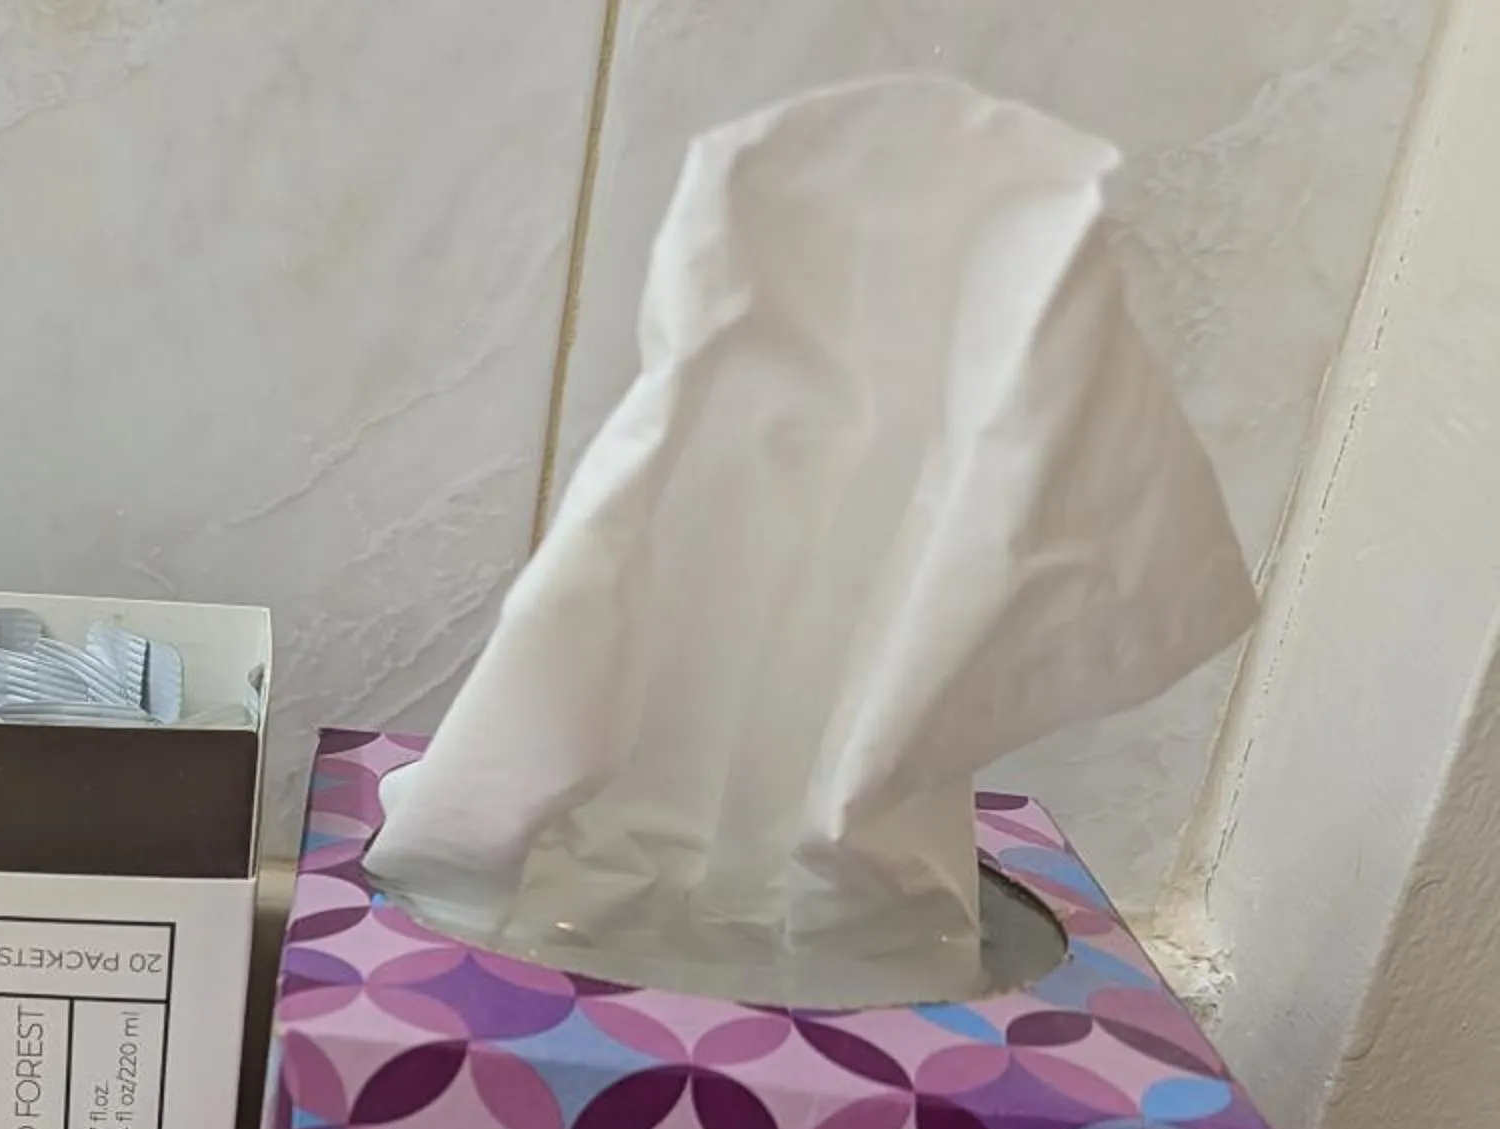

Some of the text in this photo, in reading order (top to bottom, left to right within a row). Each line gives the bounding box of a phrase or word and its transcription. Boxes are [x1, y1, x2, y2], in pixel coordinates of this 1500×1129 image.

[129, 951, 163, 973] 20
[120, 1011, 141, 1037] ml
[15, 1005, 46, 1118] FOREST
[116, 1042, 138, 1106] oz/220
[115, 1111, 133, 1122] fl
